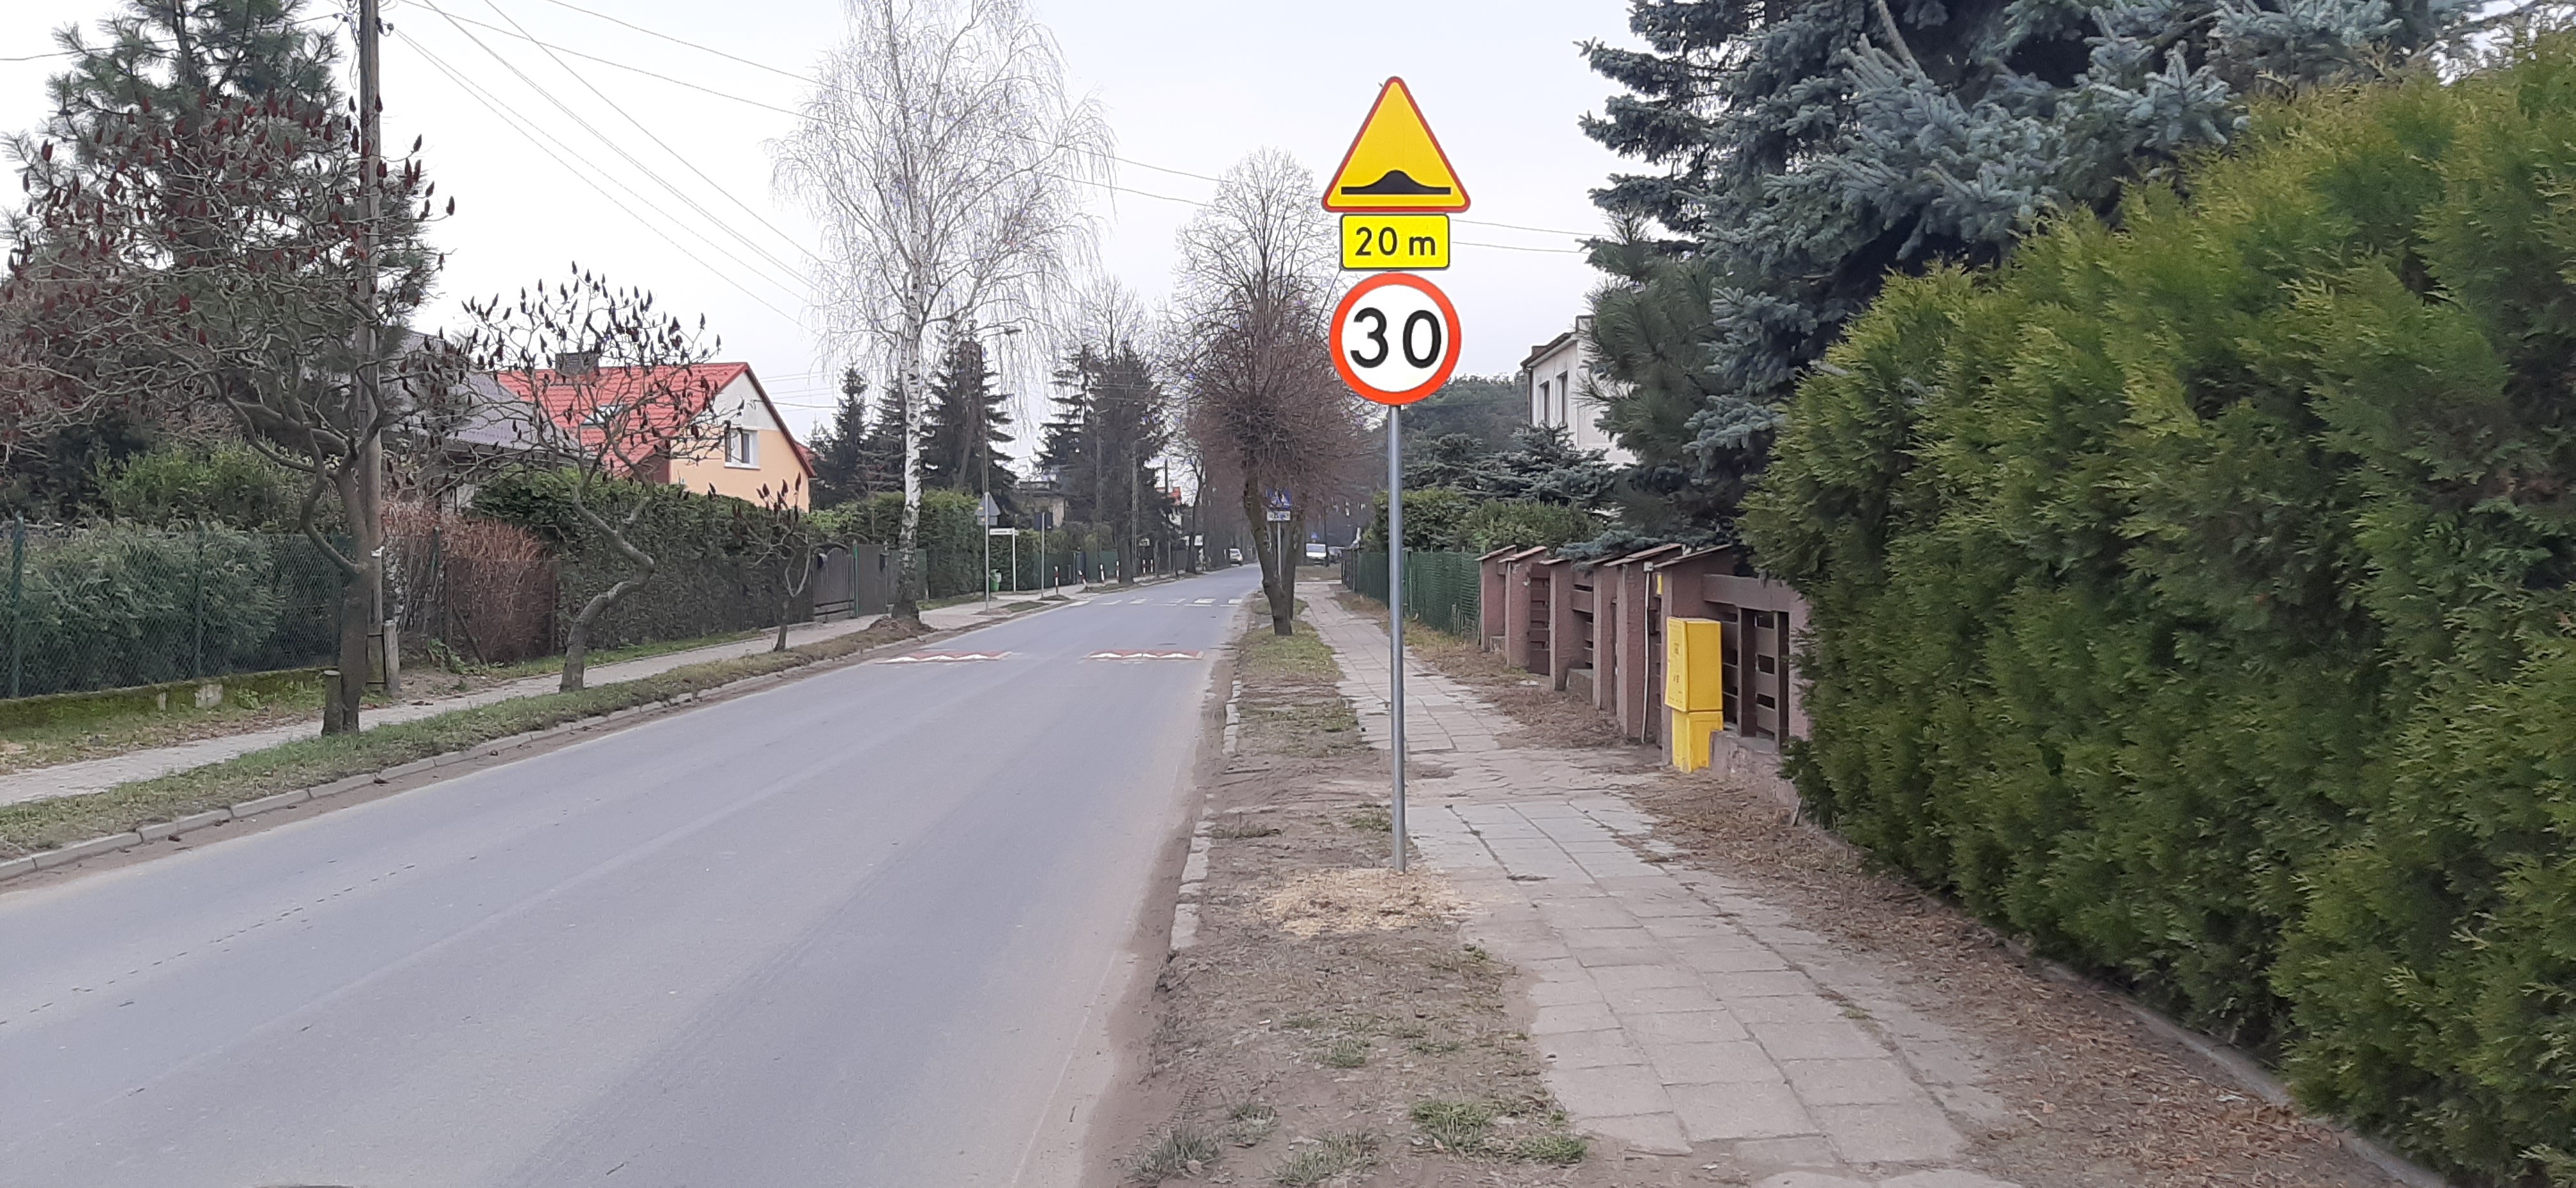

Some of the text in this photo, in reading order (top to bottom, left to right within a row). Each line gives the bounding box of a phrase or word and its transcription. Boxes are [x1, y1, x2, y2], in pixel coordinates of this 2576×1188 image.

[1355, 227, 1436, 255] 20 m
[1350, 307, 1441, 369] 30
